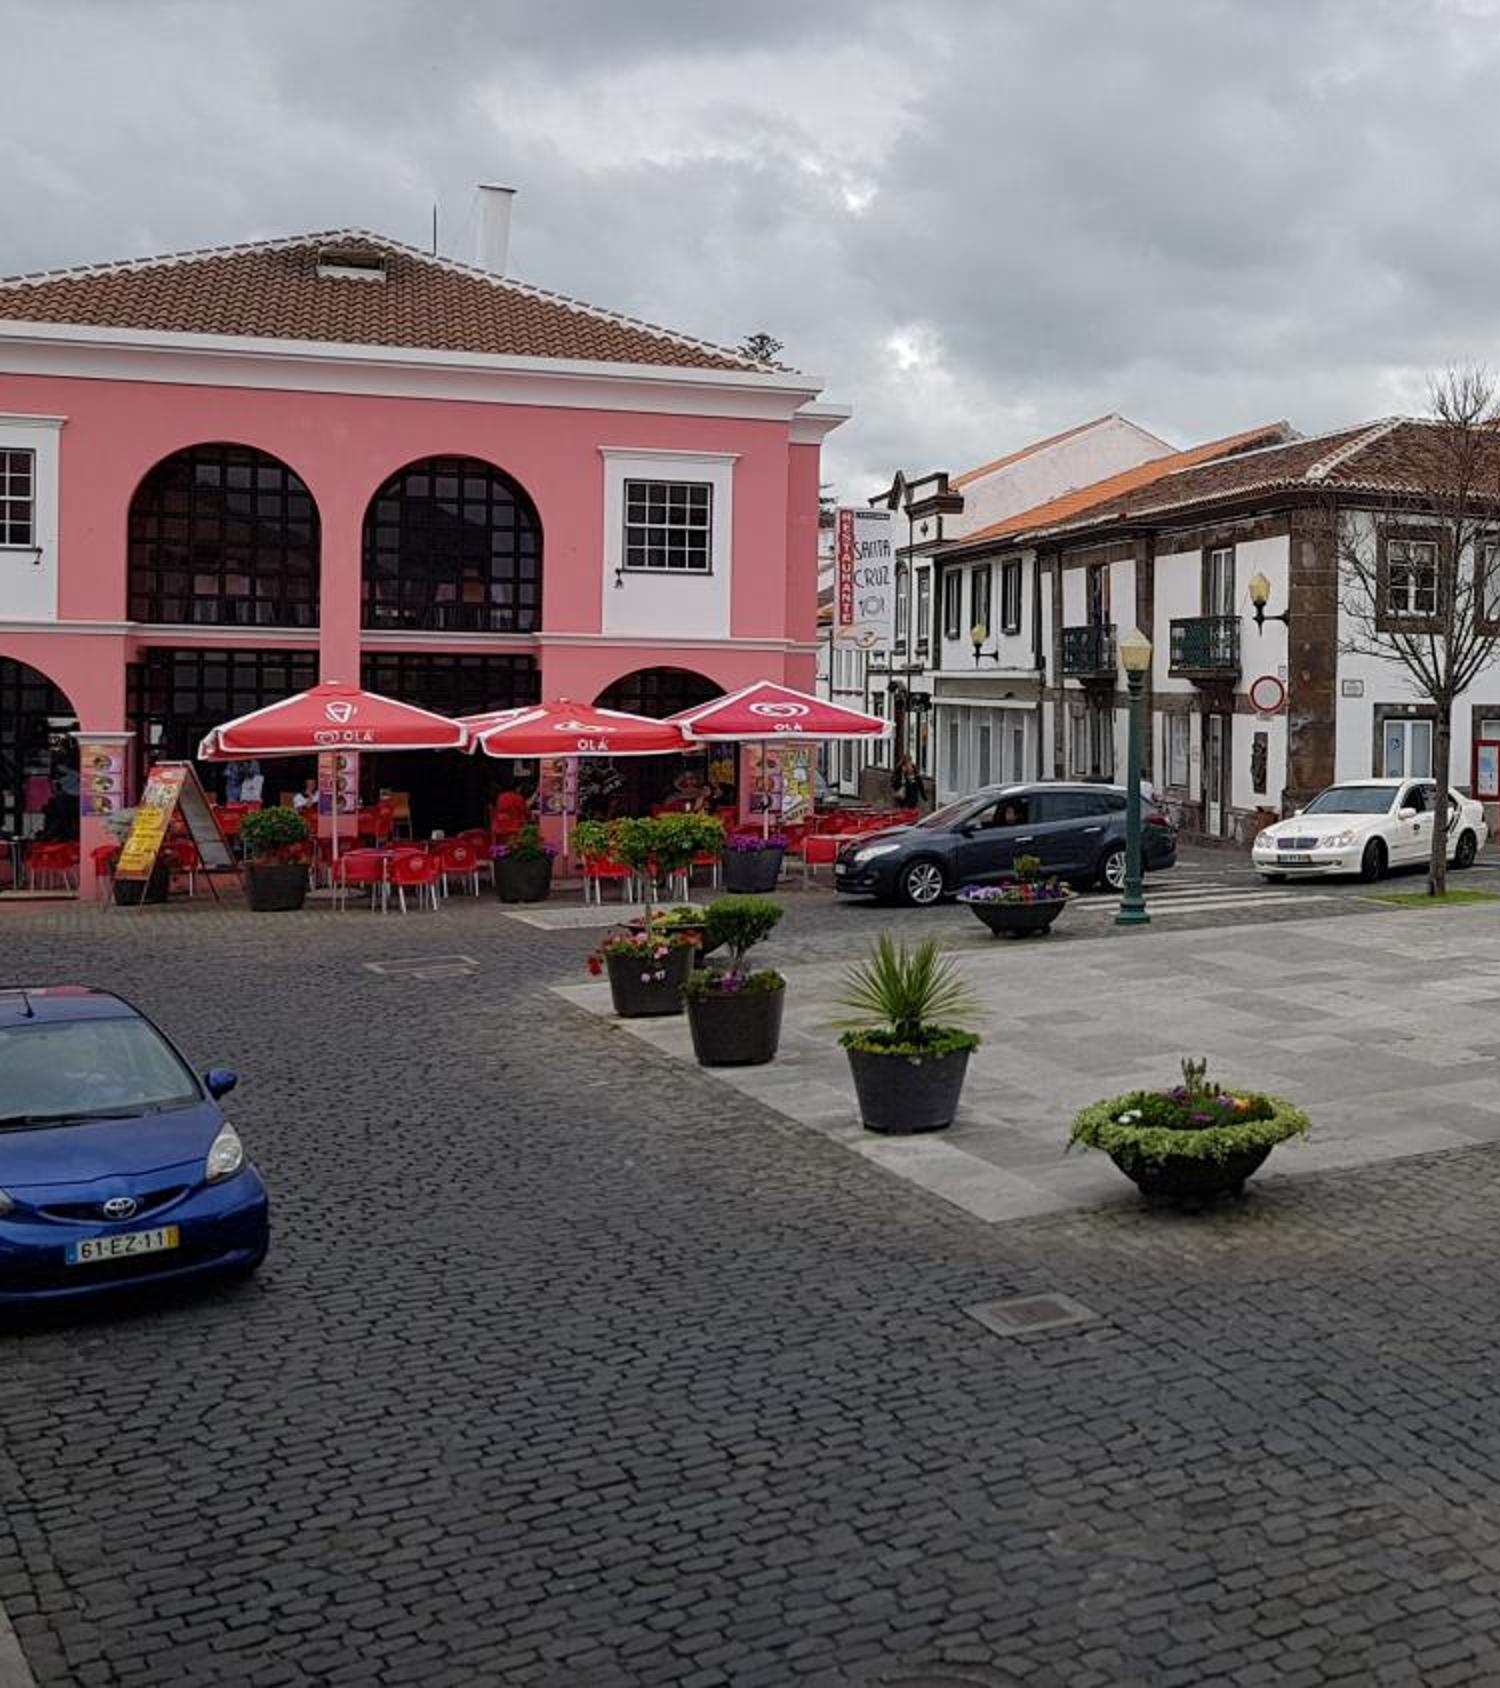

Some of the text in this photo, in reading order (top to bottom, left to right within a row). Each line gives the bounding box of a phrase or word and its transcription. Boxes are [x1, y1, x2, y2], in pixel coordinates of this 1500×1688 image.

[854, 540, 890, 560] SANTA
[840, 511, 853, 624] RESTAURANTE
[854, 566, 890, 588] CRUZ
